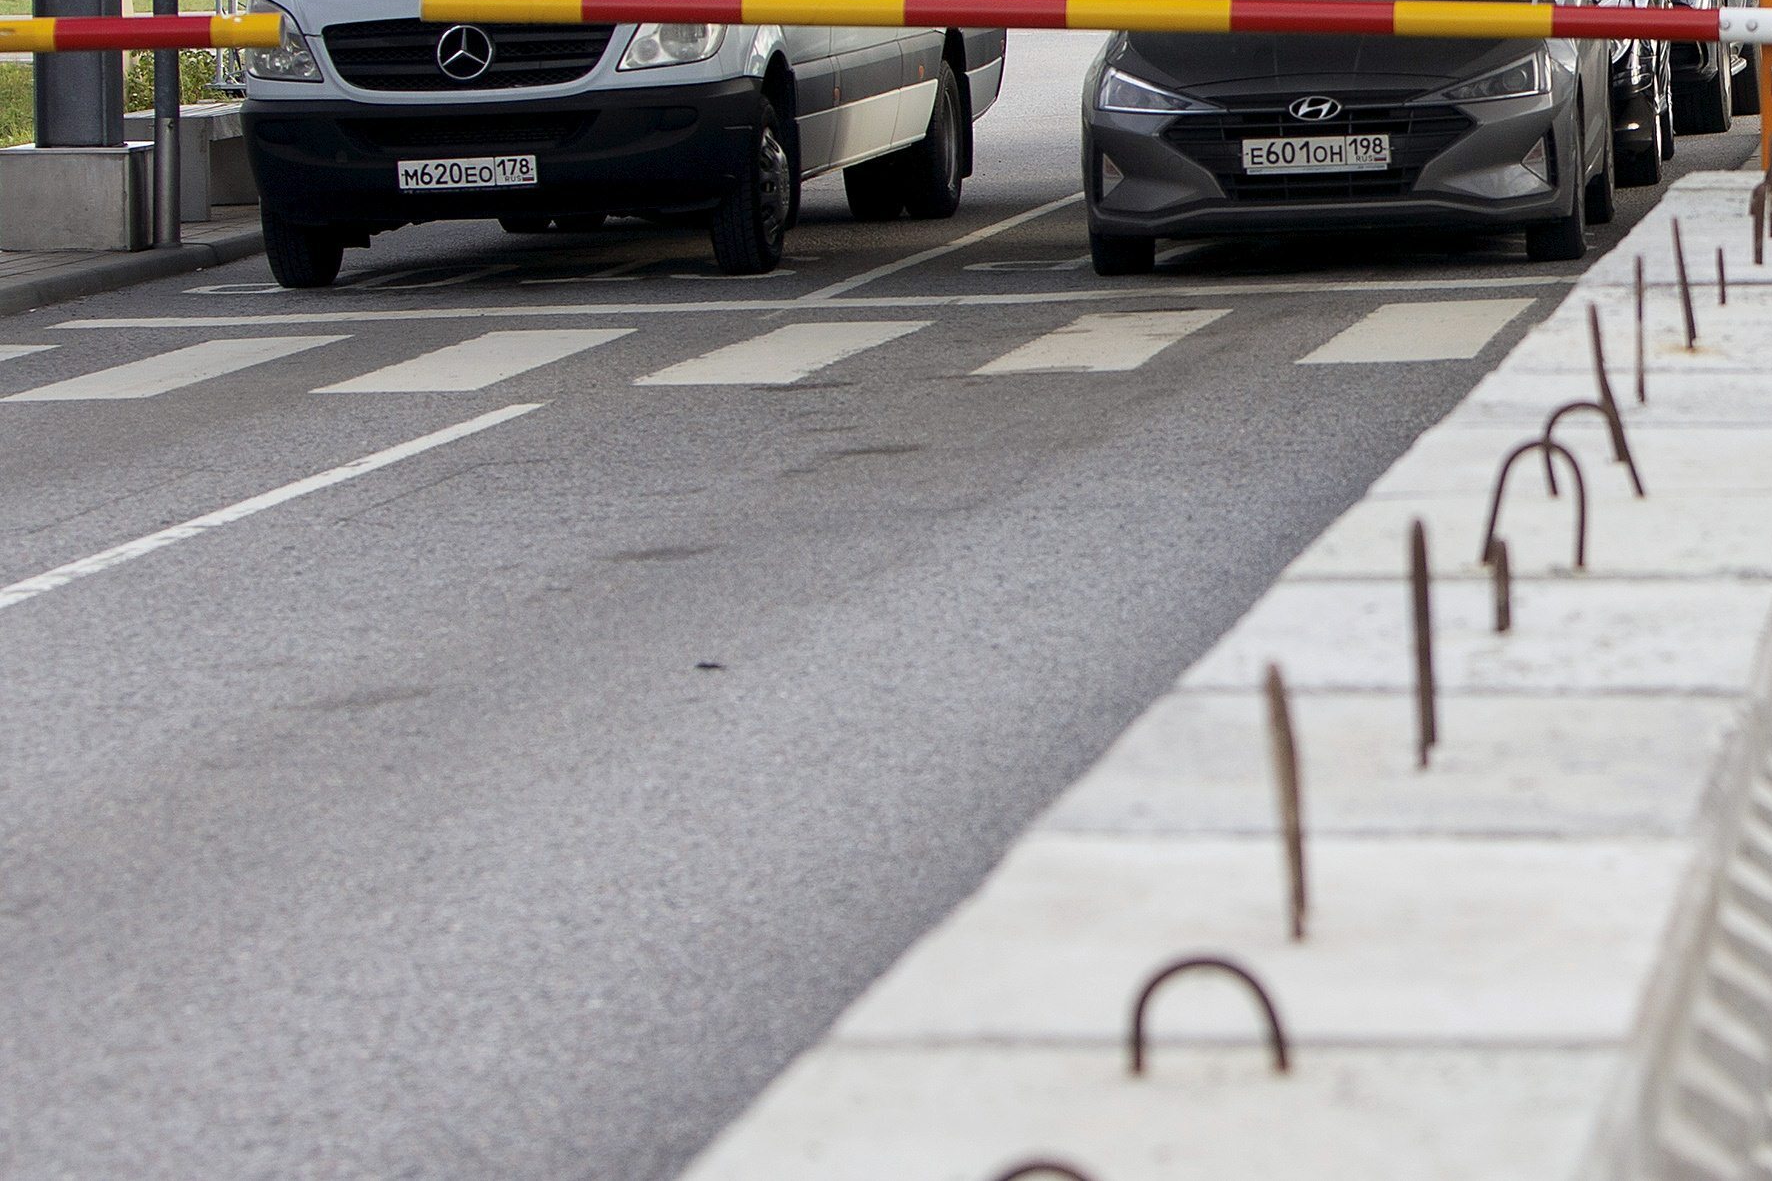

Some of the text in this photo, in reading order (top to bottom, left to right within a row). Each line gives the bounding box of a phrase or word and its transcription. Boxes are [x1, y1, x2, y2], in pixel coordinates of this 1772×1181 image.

[1251, 137, 1383, 165] Е601ОН 198
[1356, 155, 1373, 163] RUS
[404, 158, 530, 186] М620ЕО 178
